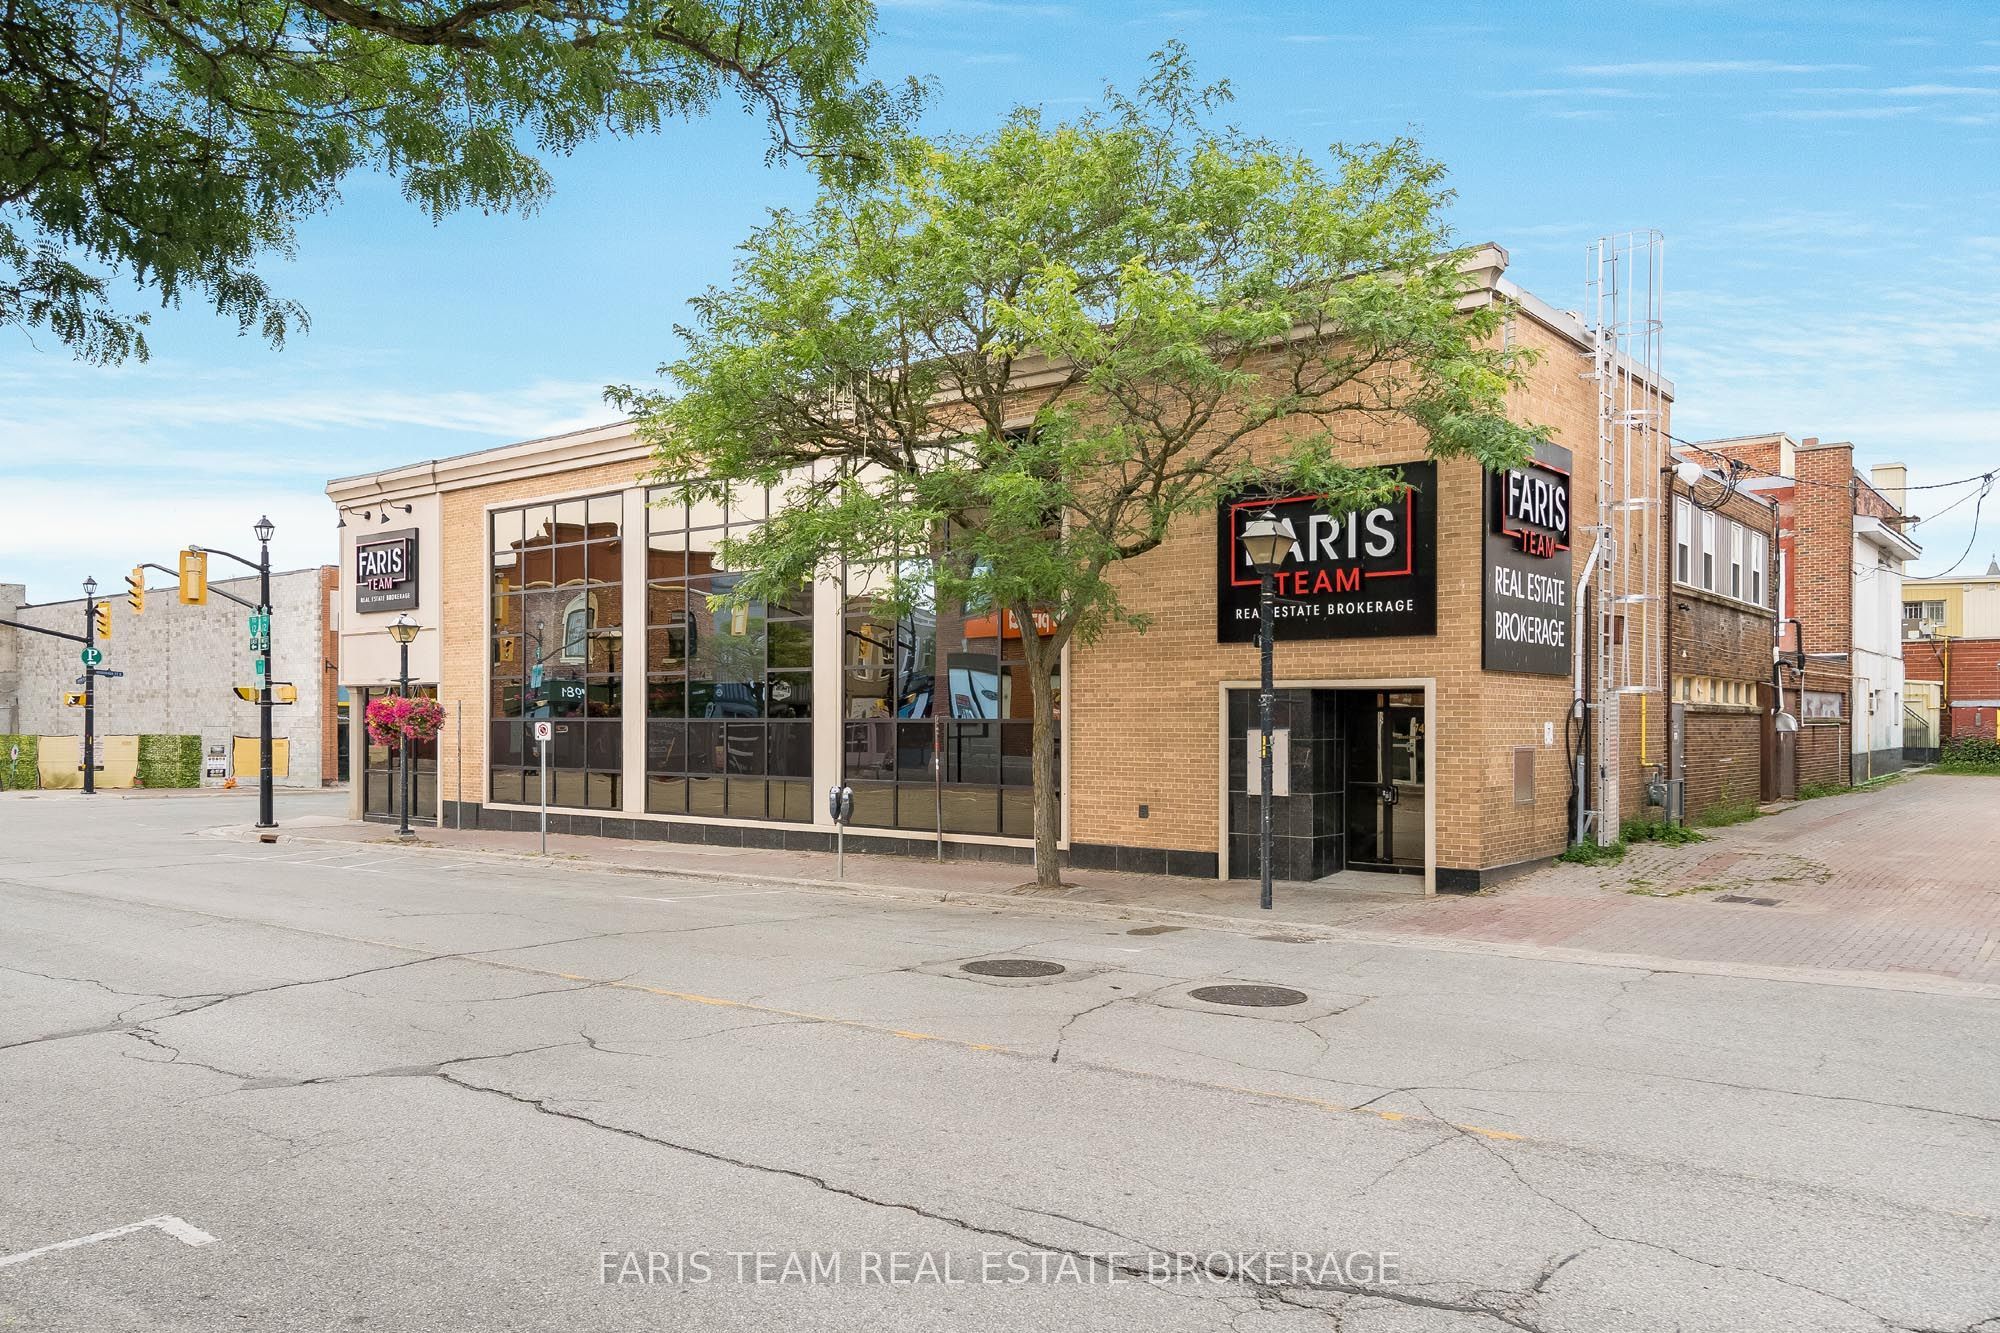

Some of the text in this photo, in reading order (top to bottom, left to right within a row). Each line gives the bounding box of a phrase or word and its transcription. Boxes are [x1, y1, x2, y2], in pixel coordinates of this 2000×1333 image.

[1508, 470, 1566, 532] FARIS
[1245, 507, 1396, 566] ARIS
[1521, 527, 1556, 560] TEAM
[358, 547, 402, 577] FARIS
[367, 577, 393, 591] TEAM
[1273, 567, 1361, 596] TEAM
[1495, 565, 1565, 607] REAL ESTATE
[1235, 599, 1414, 620] REA ESTATE BROKERAGE
[1495, 610, 1565, 648] BROKERAGE
[87, 649, 98, 661] P
